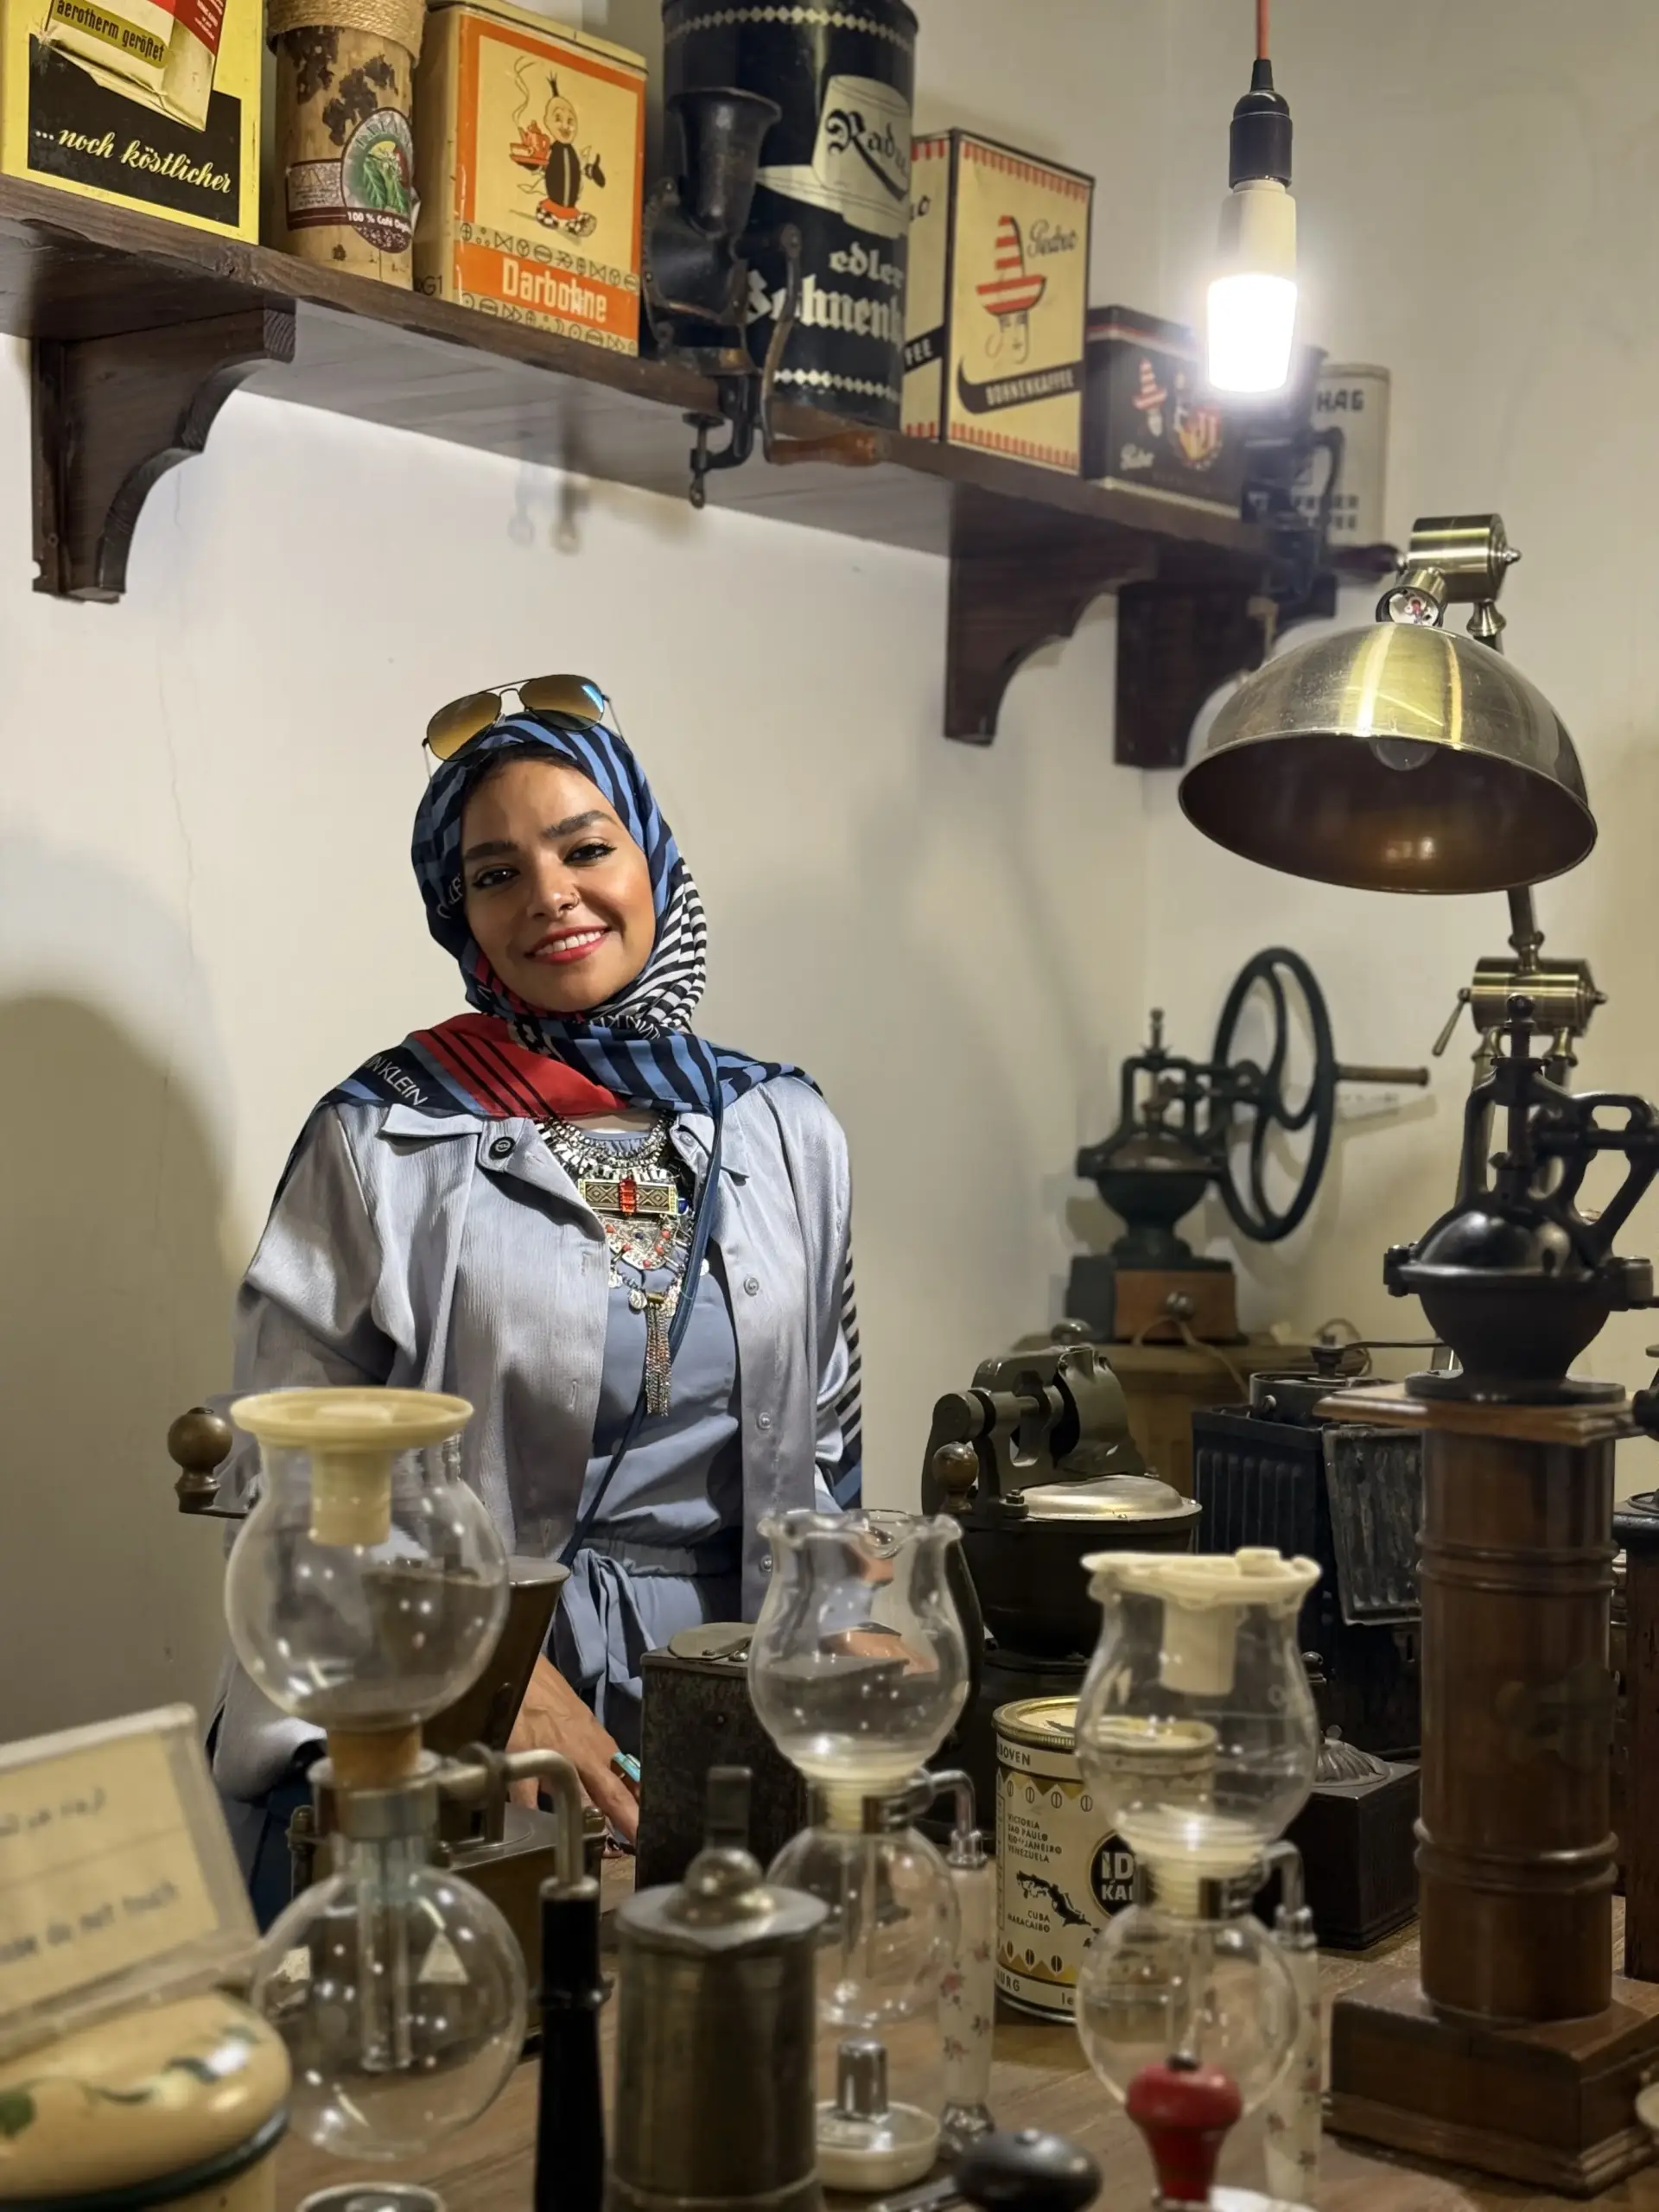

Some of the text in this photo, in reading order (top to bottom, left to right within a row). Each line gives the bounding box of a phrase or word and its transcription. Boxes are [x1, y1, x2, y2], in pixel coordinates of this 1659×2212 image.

[57, 0, 119, 39] aerotherm
[120, 139, 232, 194] köstlicher
[347, 212, 364, 222] 100
[829, 241, 905, 290] edler
[1317, 390, 1364, 412] HAG
[378, 1061, 429, 1106] KLEIN
[1007, 1813, 1040, 1830] VICTORIA
[1021, 1829, 1048, 1842] PAULO
[1007, 1844, 1050, 1864] VENEZUELA
[1024, 1840, 1063, 1855] JANEIRO
[1007, 1912, 1051, 1934] MARACAIBO
[1027, 1910, 1051, 1923] CUBA
